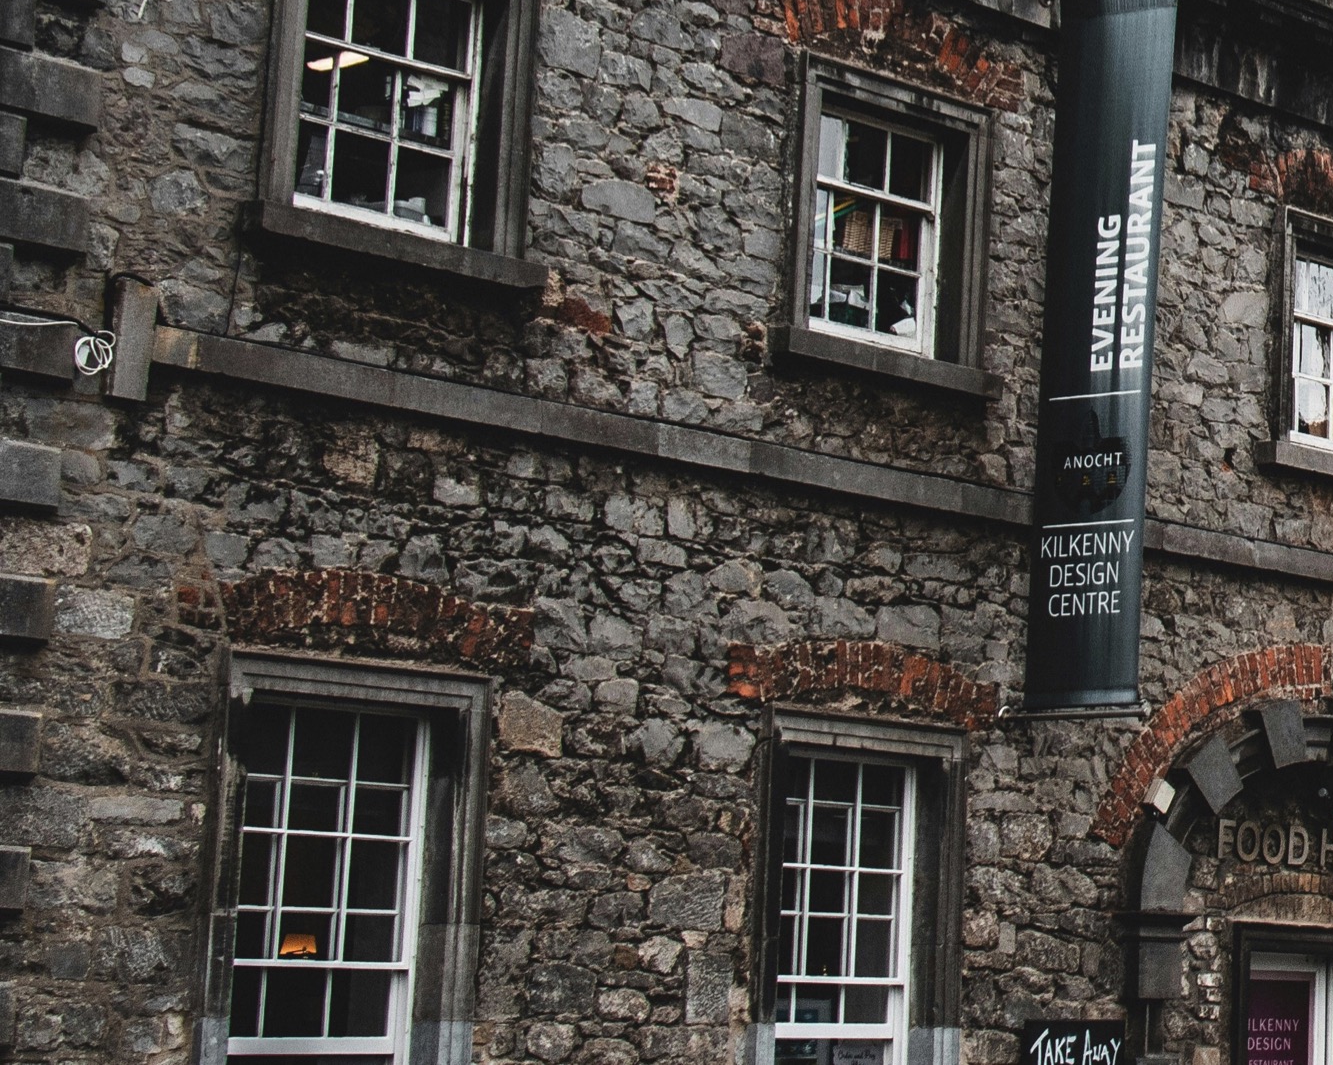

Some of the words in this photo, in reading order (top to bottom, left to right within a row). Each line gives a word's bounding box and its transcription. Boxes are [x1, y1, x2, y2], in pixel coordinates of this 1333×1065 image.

[1119, 139, 1157, 369] RESTAURANT
[1090, 214, 1122, 372] EVENING
[1063, 451, 1123, 469] ANOCHT
[1041, 530, 1134, 558] KILKENNY
[1049, 561, 1119, 587] DESIGN
[1048, 590, 1121, 617] CENTRE
[1217, 818, 1310, 866] FOOD
[1029, 1027, 1077, 1065] TAKE
[1247, 1036, 1292, 1051] DESIGN
